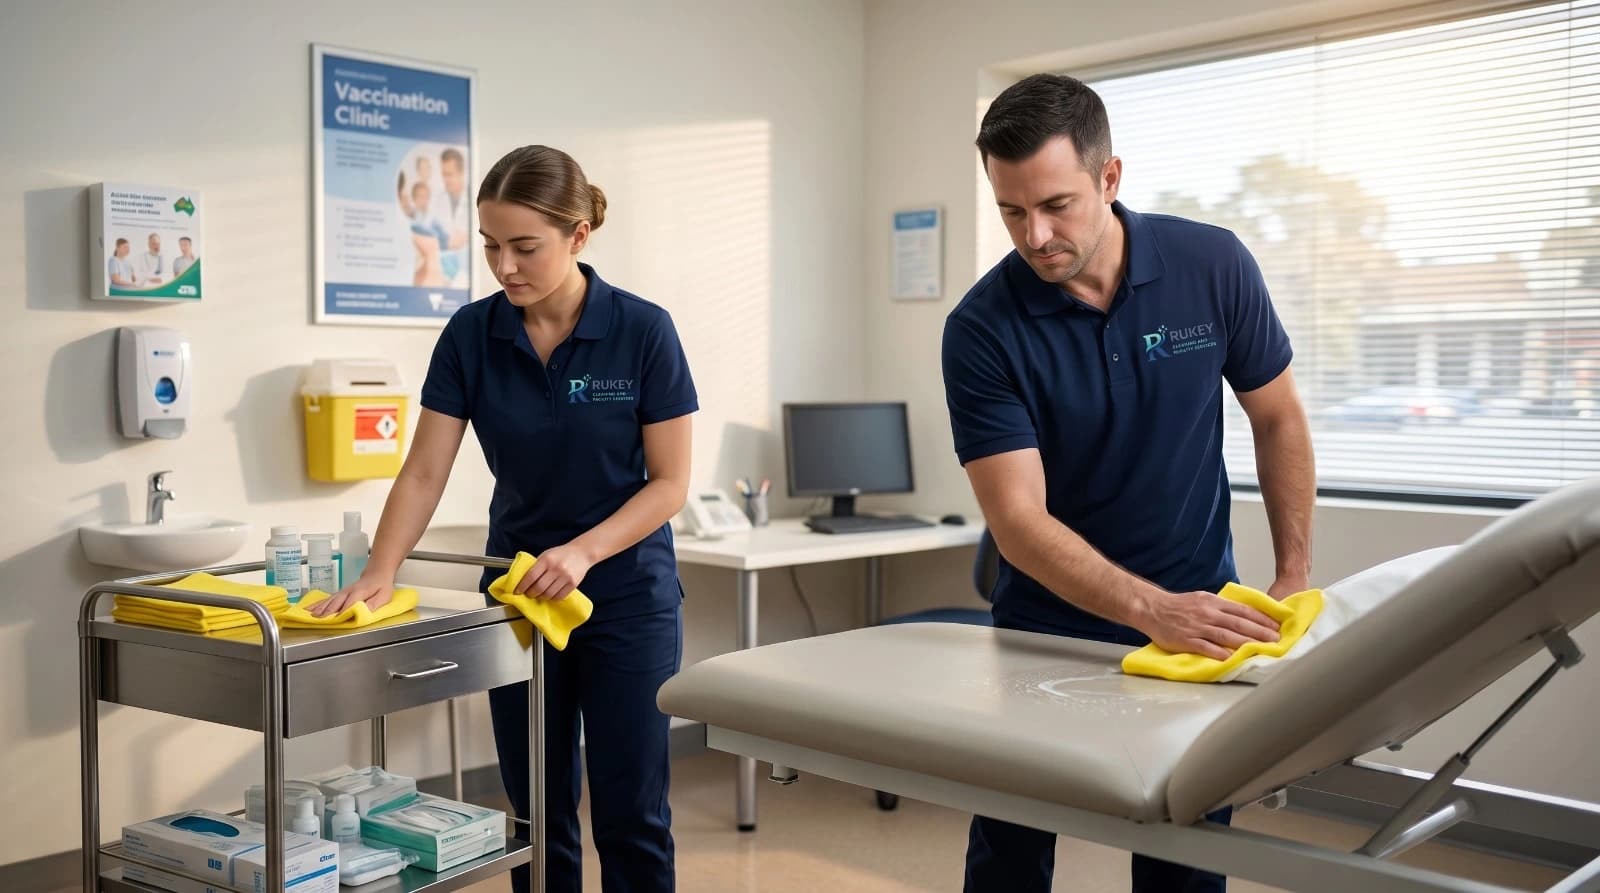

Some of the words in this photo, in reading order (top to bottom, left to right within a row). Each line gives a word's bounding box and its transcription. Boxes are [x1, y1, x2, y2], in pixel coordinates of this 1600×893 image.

[334, 79, 449, 116] Vaccination
[334, 104, 391, 130] Clinic
[1169, 322, 1213, 341] RUKEY
[592, 379, 633, 390] RUKEY
